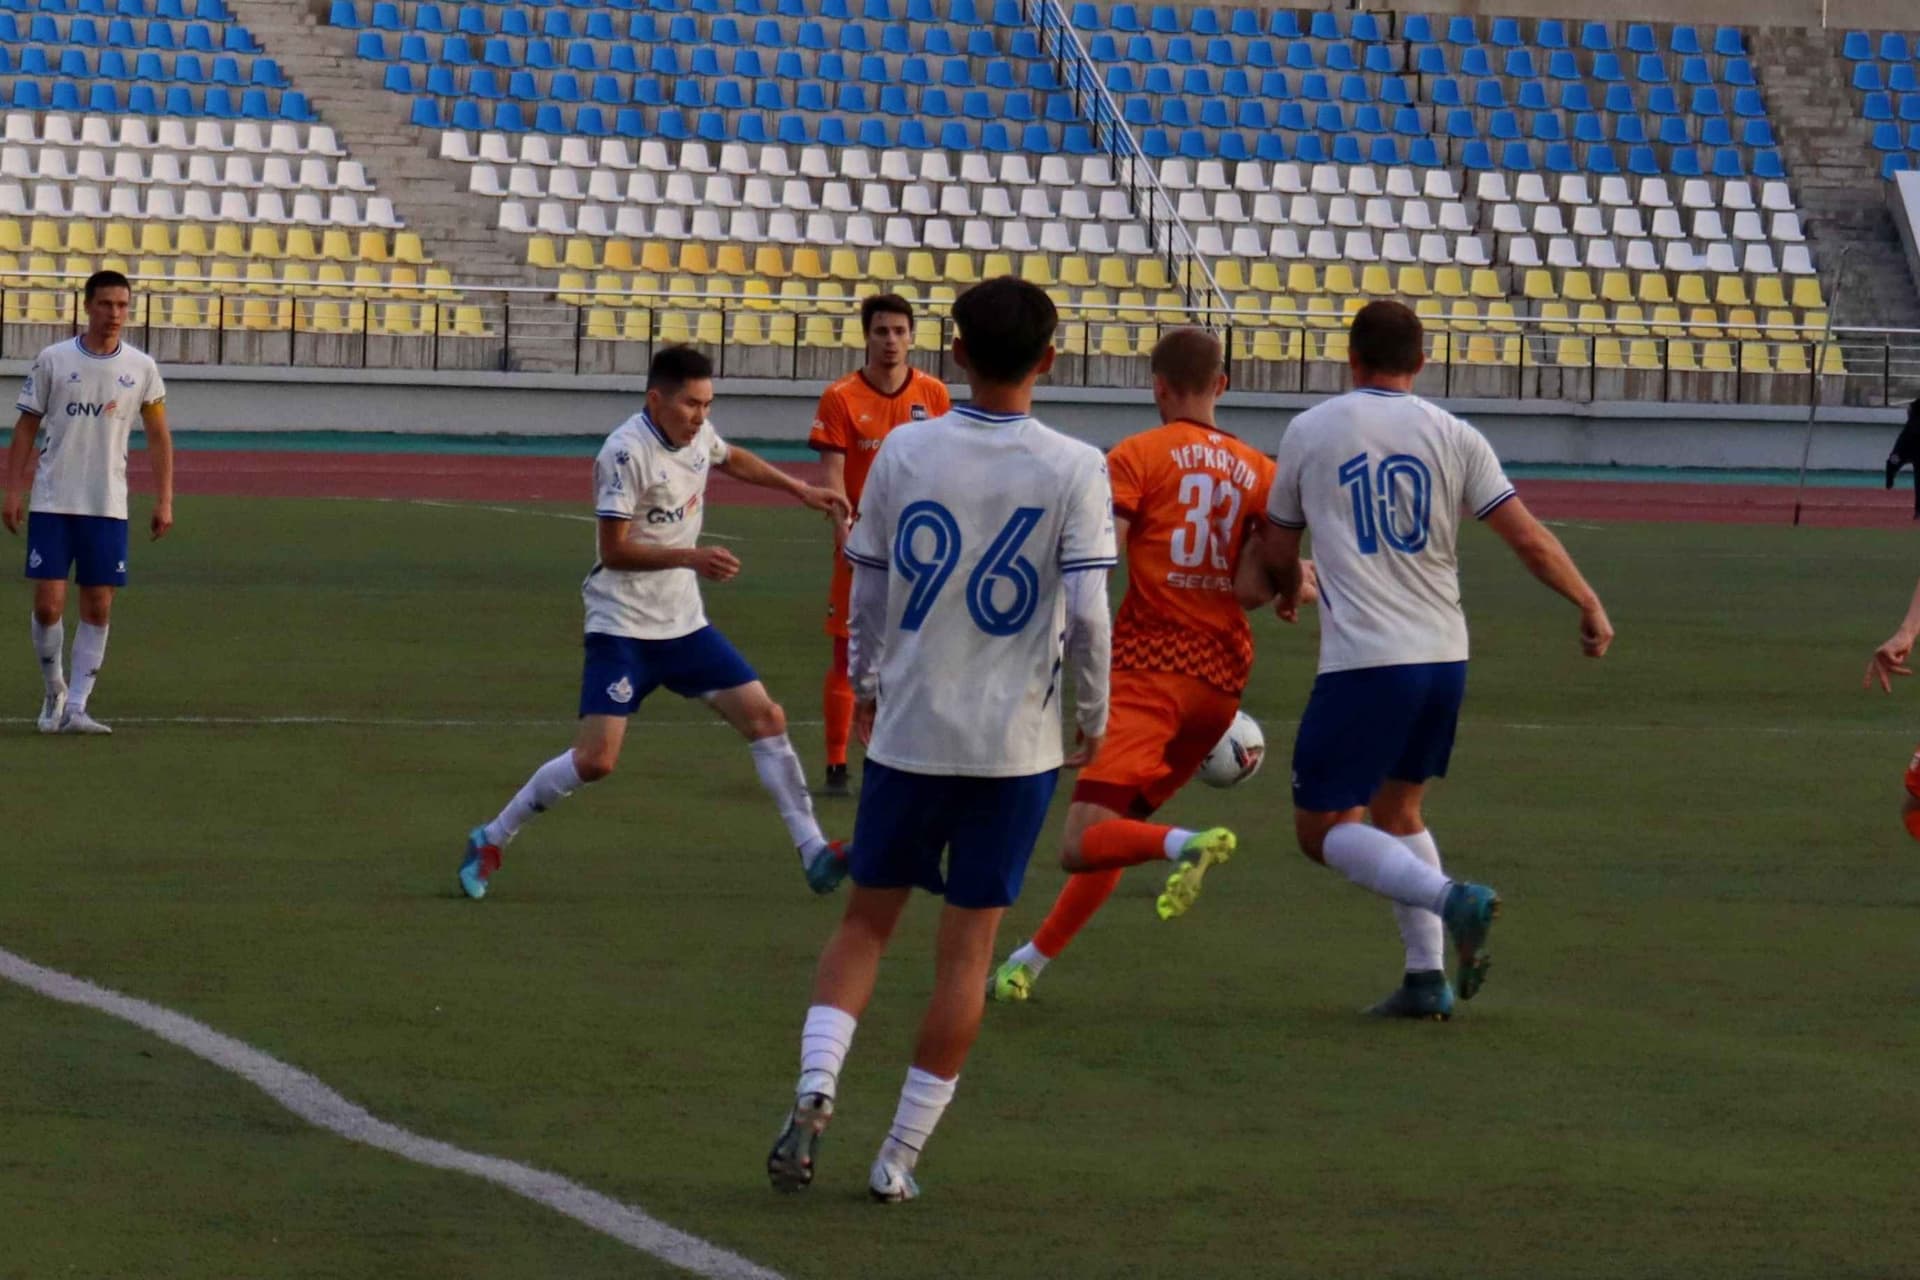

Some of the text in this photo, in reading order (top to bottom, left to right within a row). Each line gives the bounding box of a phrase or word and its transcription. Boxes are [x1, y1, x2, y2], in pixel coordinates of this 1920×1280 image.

[66, 402, 104, 417] GNV
[1339, 452, 1431, 555] 10
[894, 500, 1046, 637] 96
